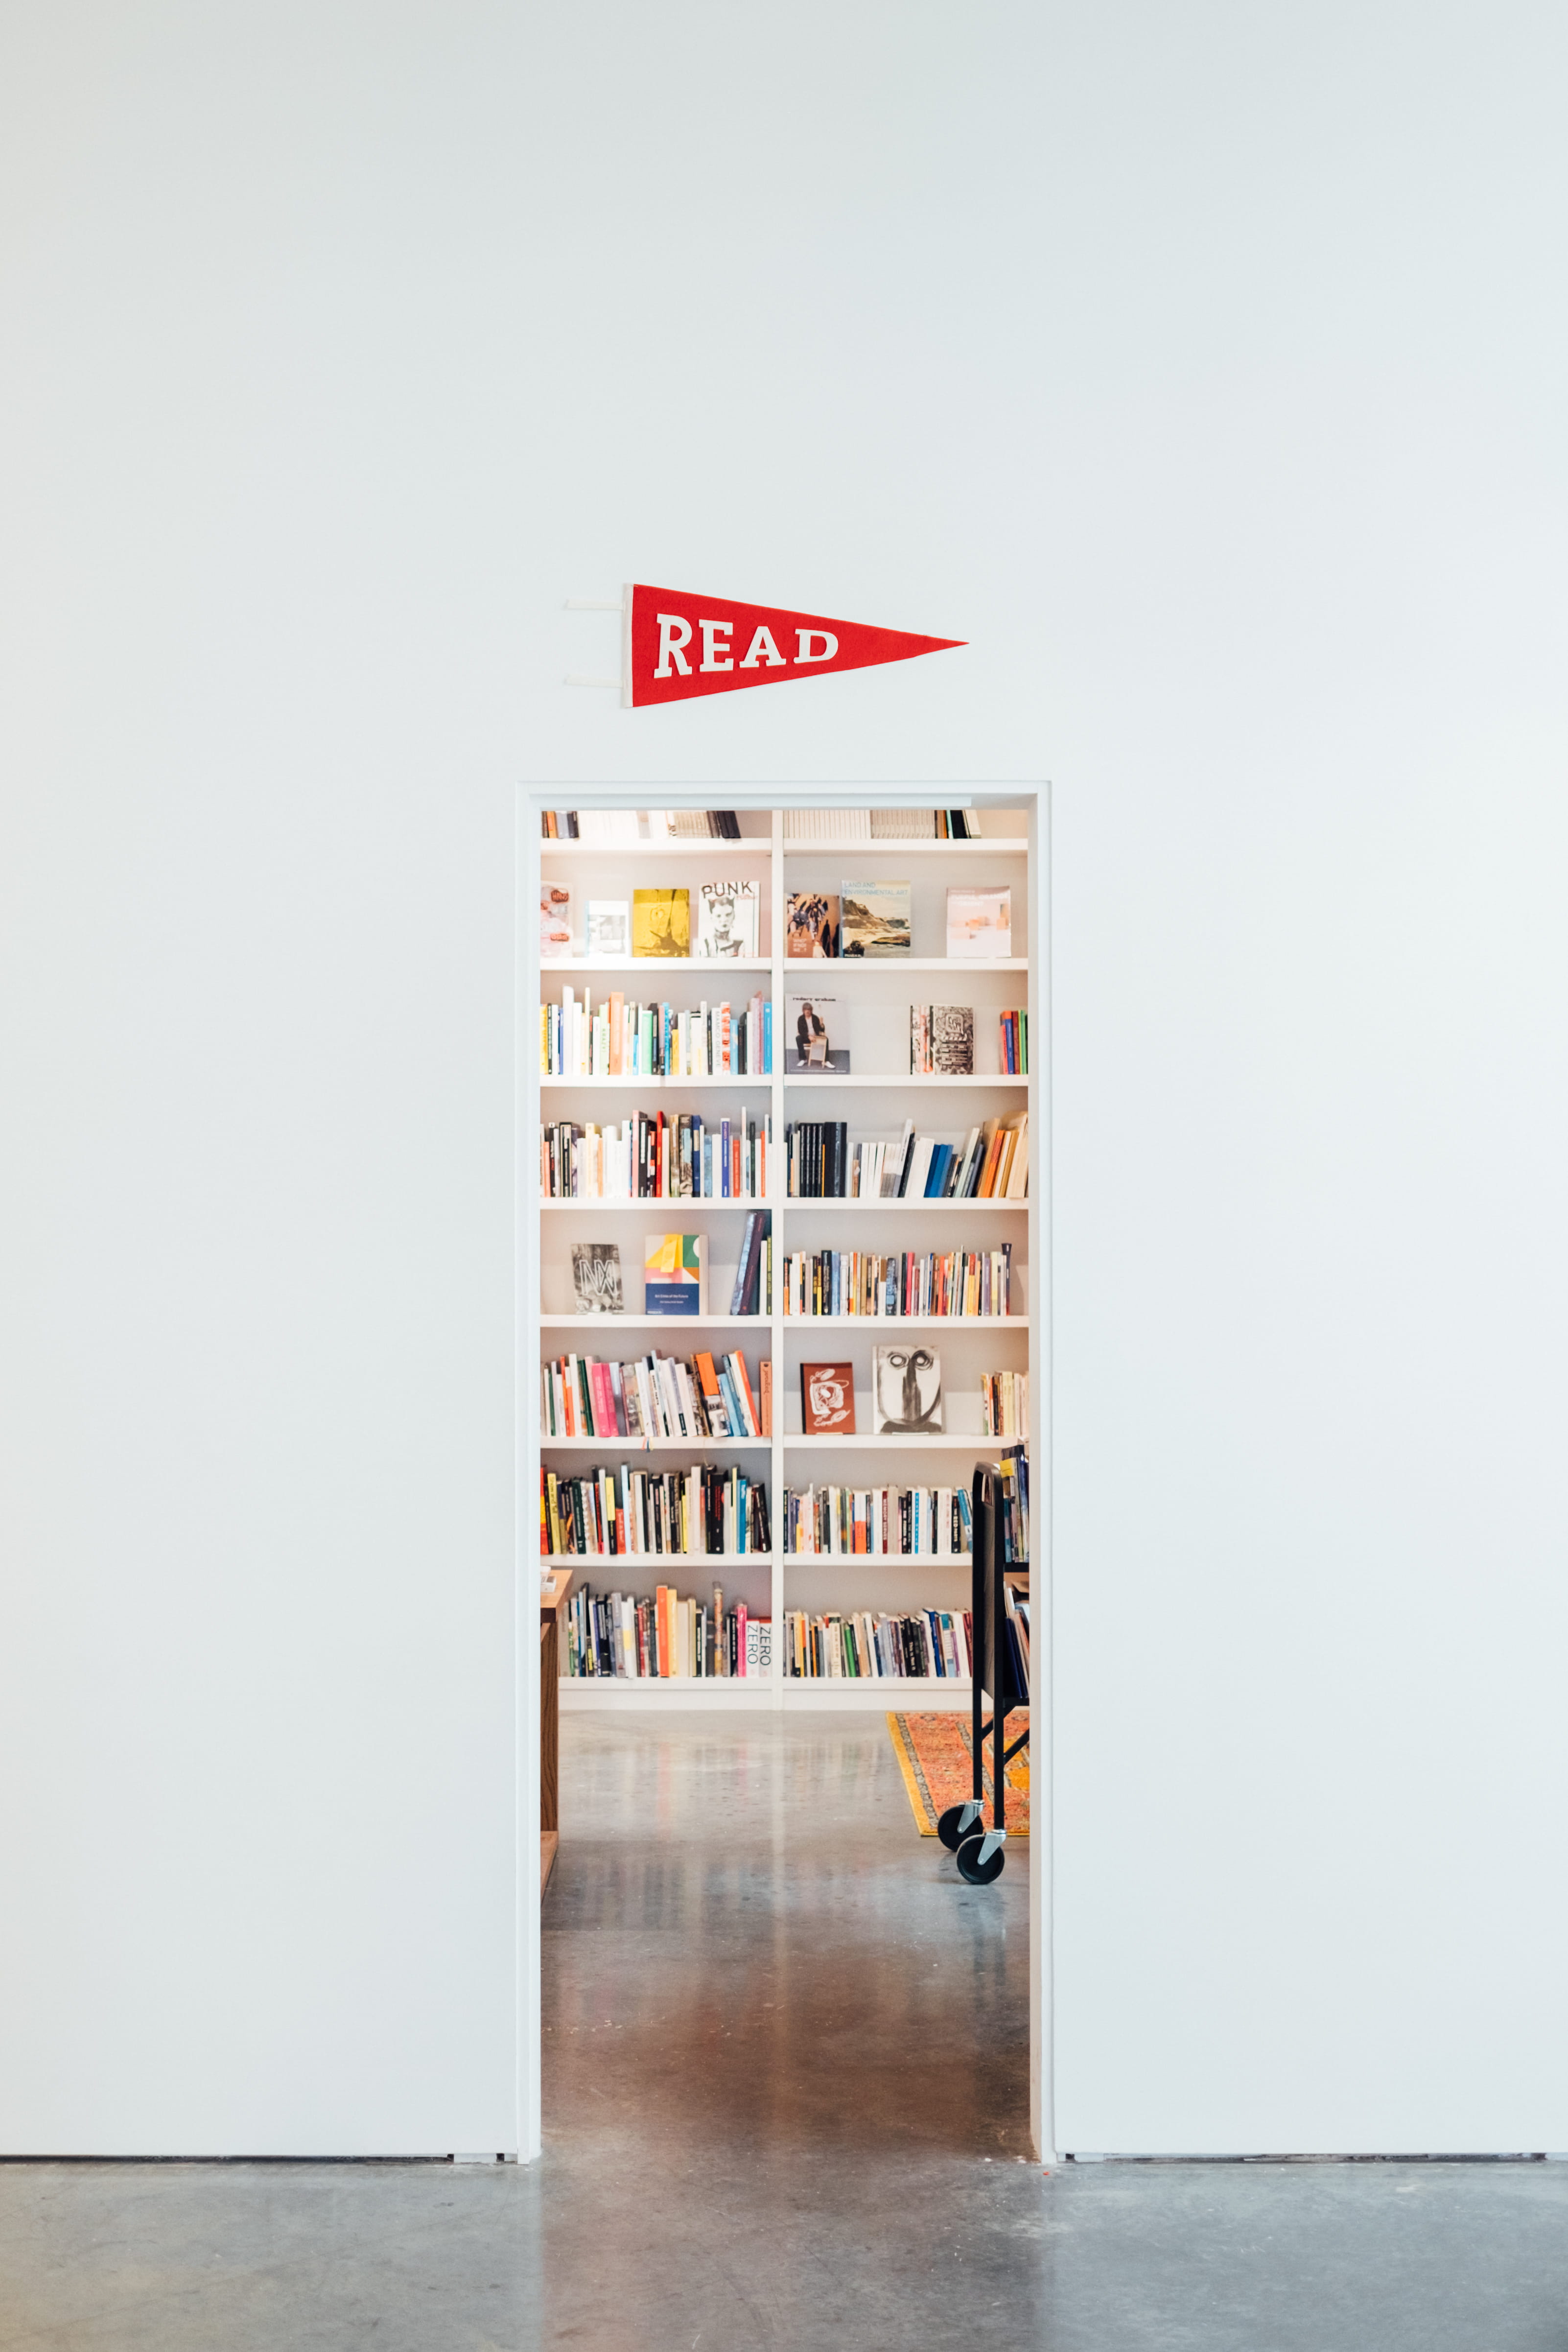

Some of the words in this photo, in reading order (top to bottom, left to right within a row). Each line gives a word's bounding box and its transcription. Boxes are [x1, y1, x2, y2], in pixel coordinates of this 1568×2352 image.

[654, 613, 840, 679] READ
[701, 881, 752, 898] PUNK
[748, 1625, 758, 1664] ZERO
[760, 1627, 771, 1666] ZERO
